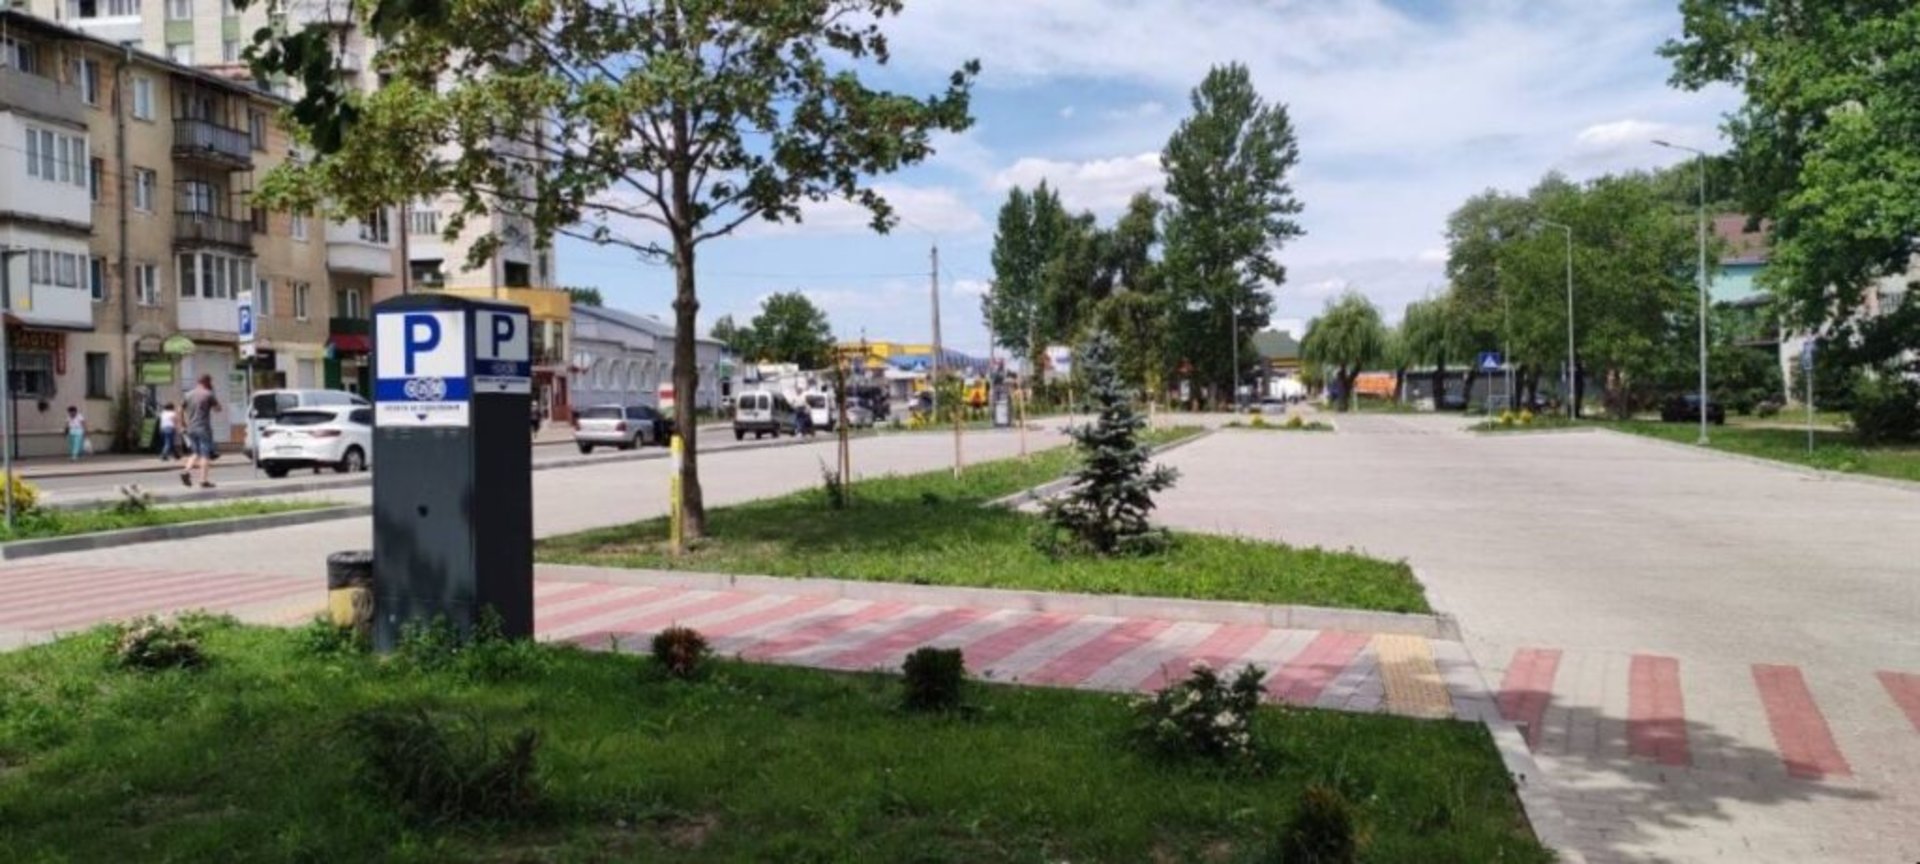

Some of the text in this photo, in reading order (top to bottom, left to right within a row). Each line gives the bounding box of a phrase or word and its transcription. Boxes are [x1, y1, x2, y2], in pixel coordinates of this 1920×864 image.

[241, 308, 250, 331] P
[492, 314, 515, 357] P
[404, 314, 441, 375] P
